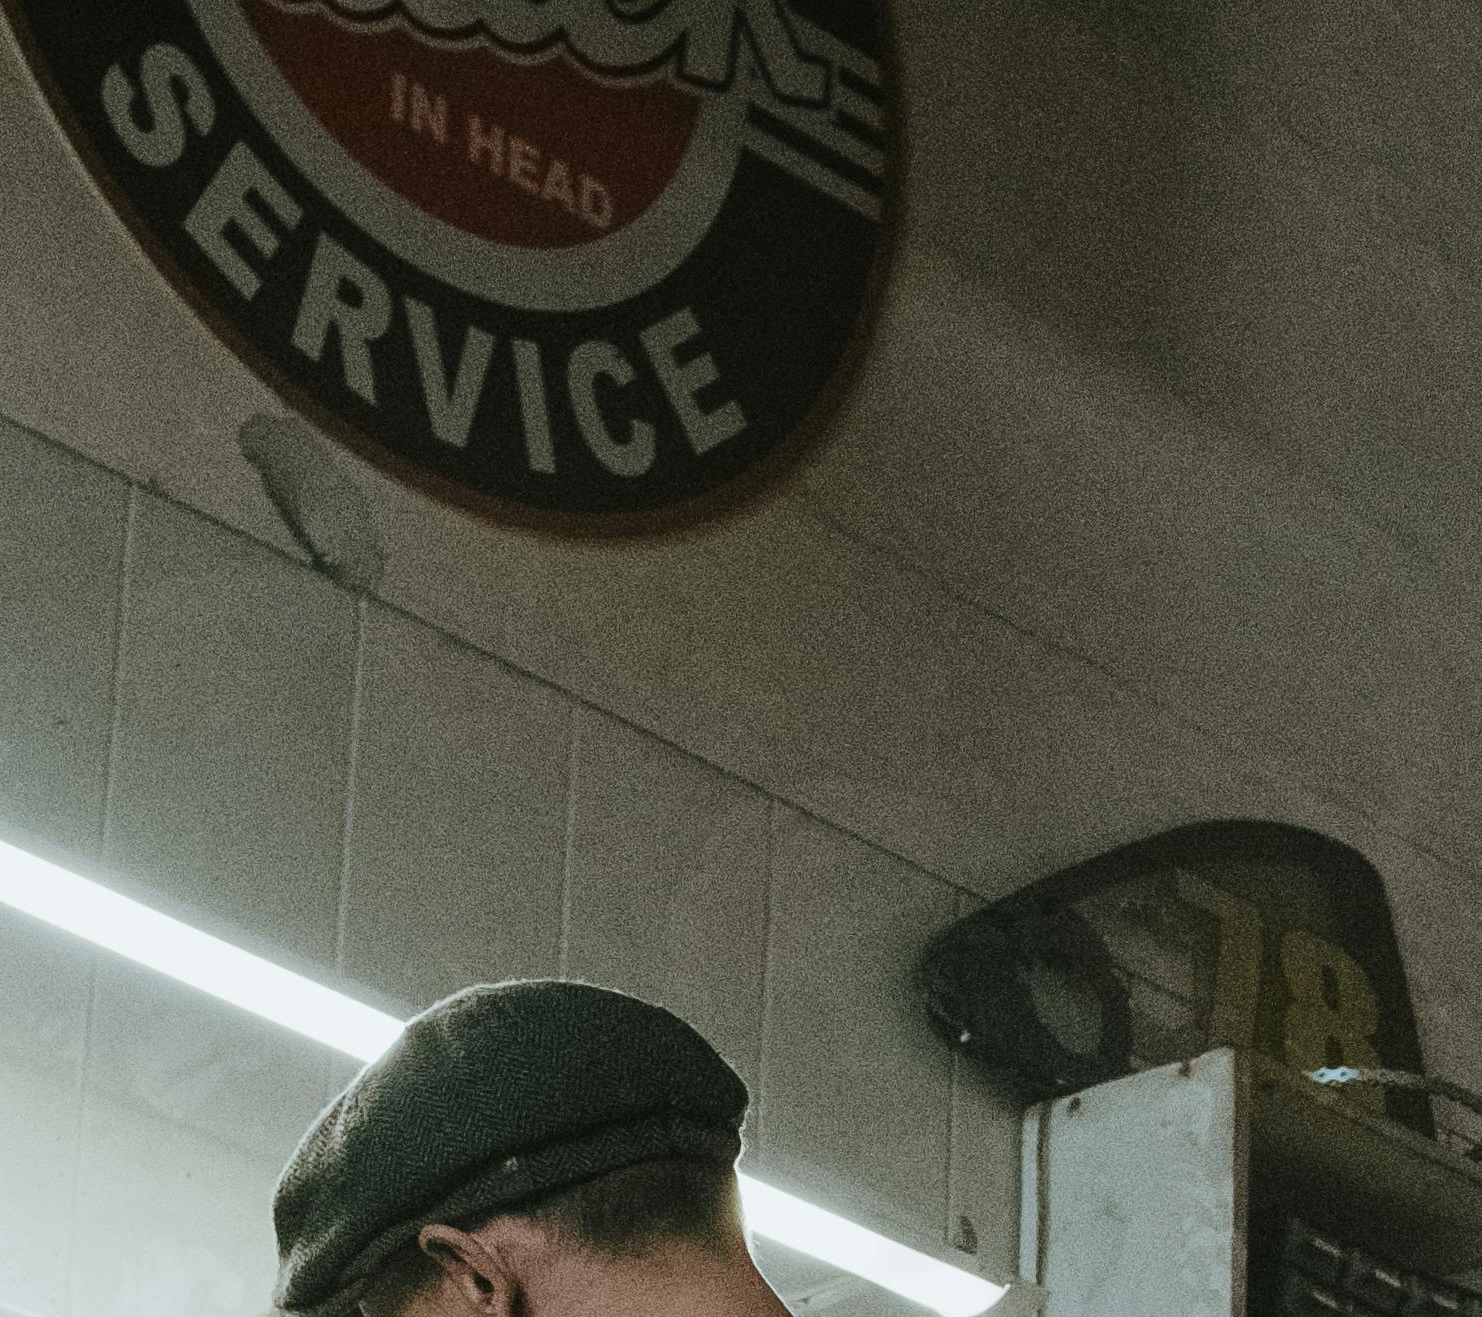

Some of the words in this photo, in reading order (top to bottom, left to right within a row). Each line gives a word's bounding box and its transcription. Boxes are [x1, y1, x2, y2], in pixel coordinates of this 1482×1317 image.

[99, 43, 747, 477] SERVICE
[389, 73, 448, 147] IN
[467, 122, 613, 230] HEAD
